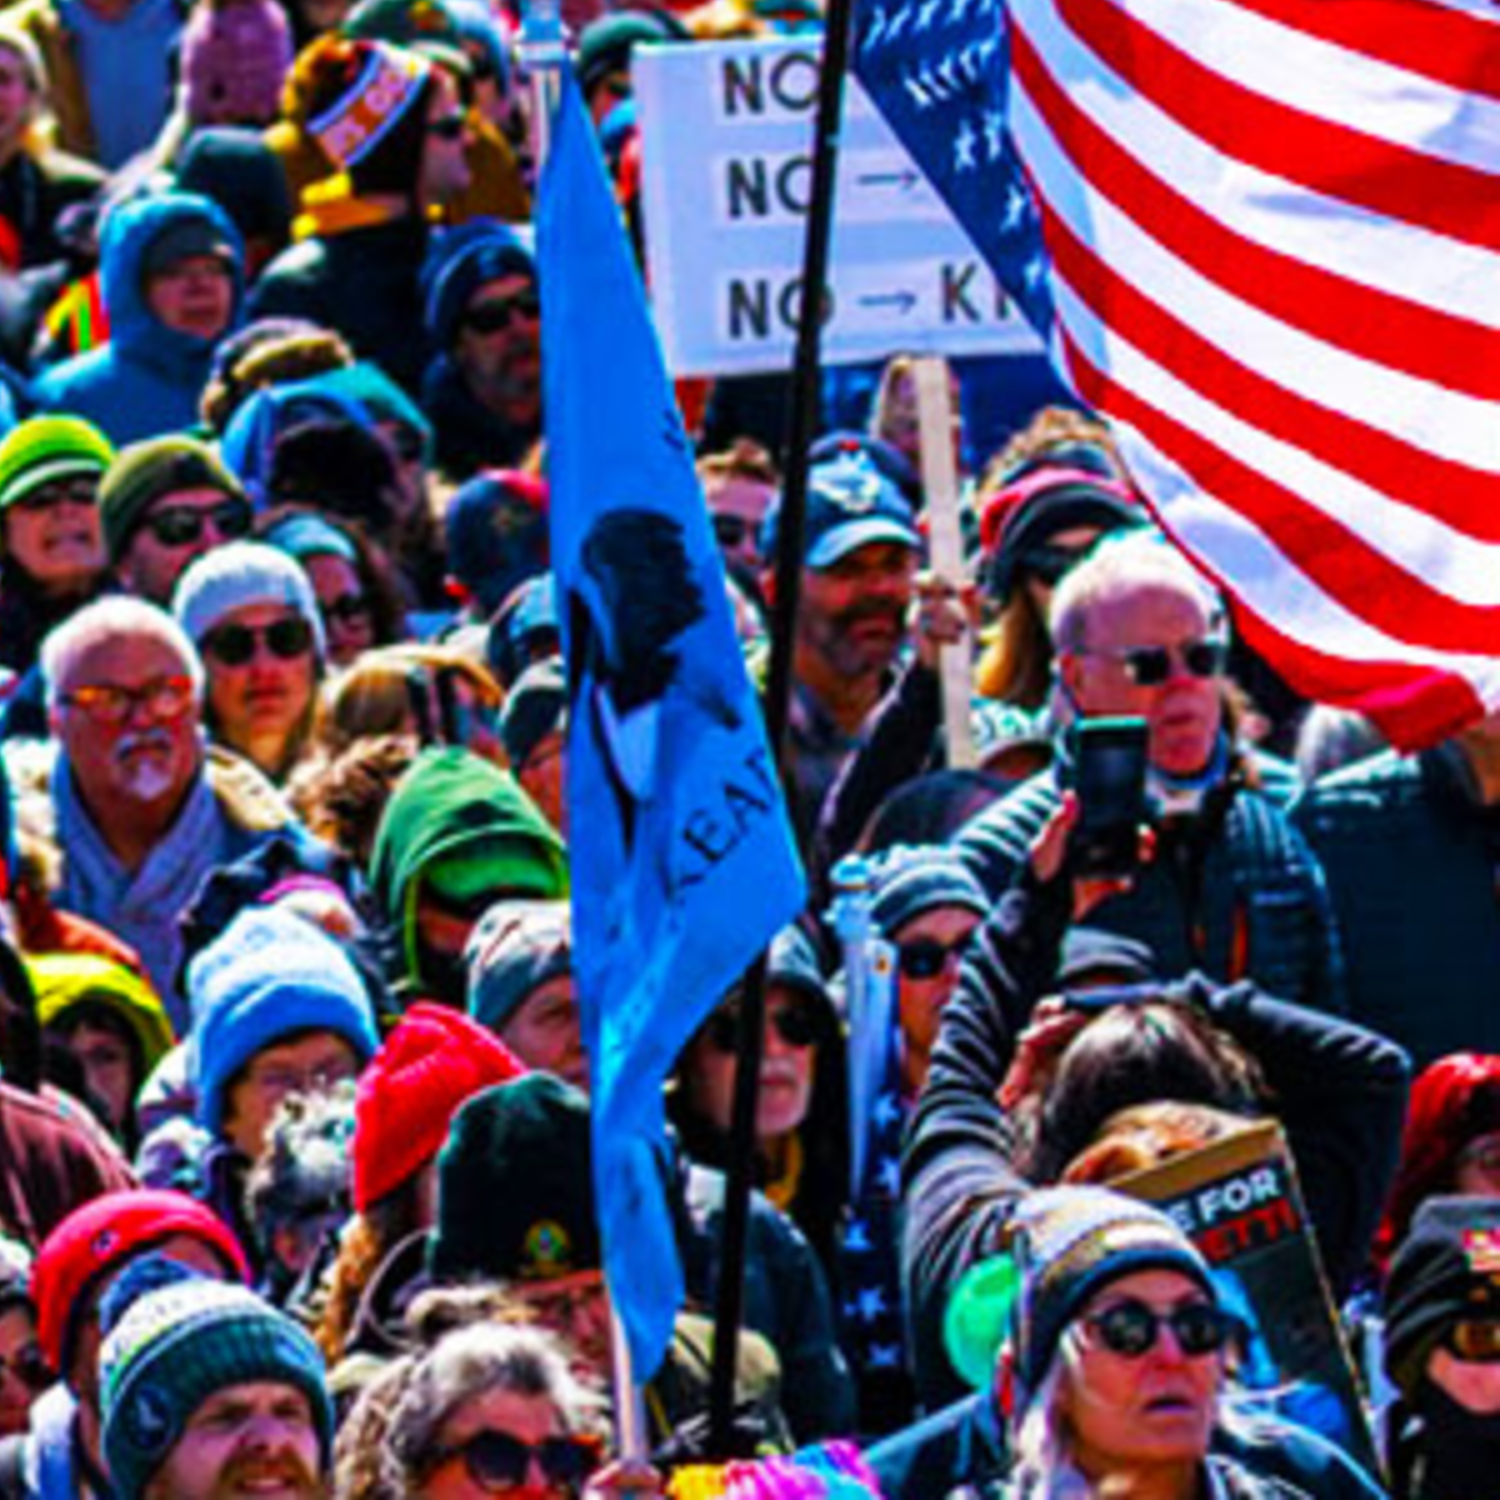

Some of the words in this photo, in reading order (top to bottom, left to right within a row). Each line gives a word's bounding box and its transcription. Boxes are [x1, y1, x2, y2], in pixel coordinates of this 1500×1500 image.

[723, 52, 822, 116] NO
[728, 278, 835, 339] NO
[1198, 1168, 1280, 1222] FOR
